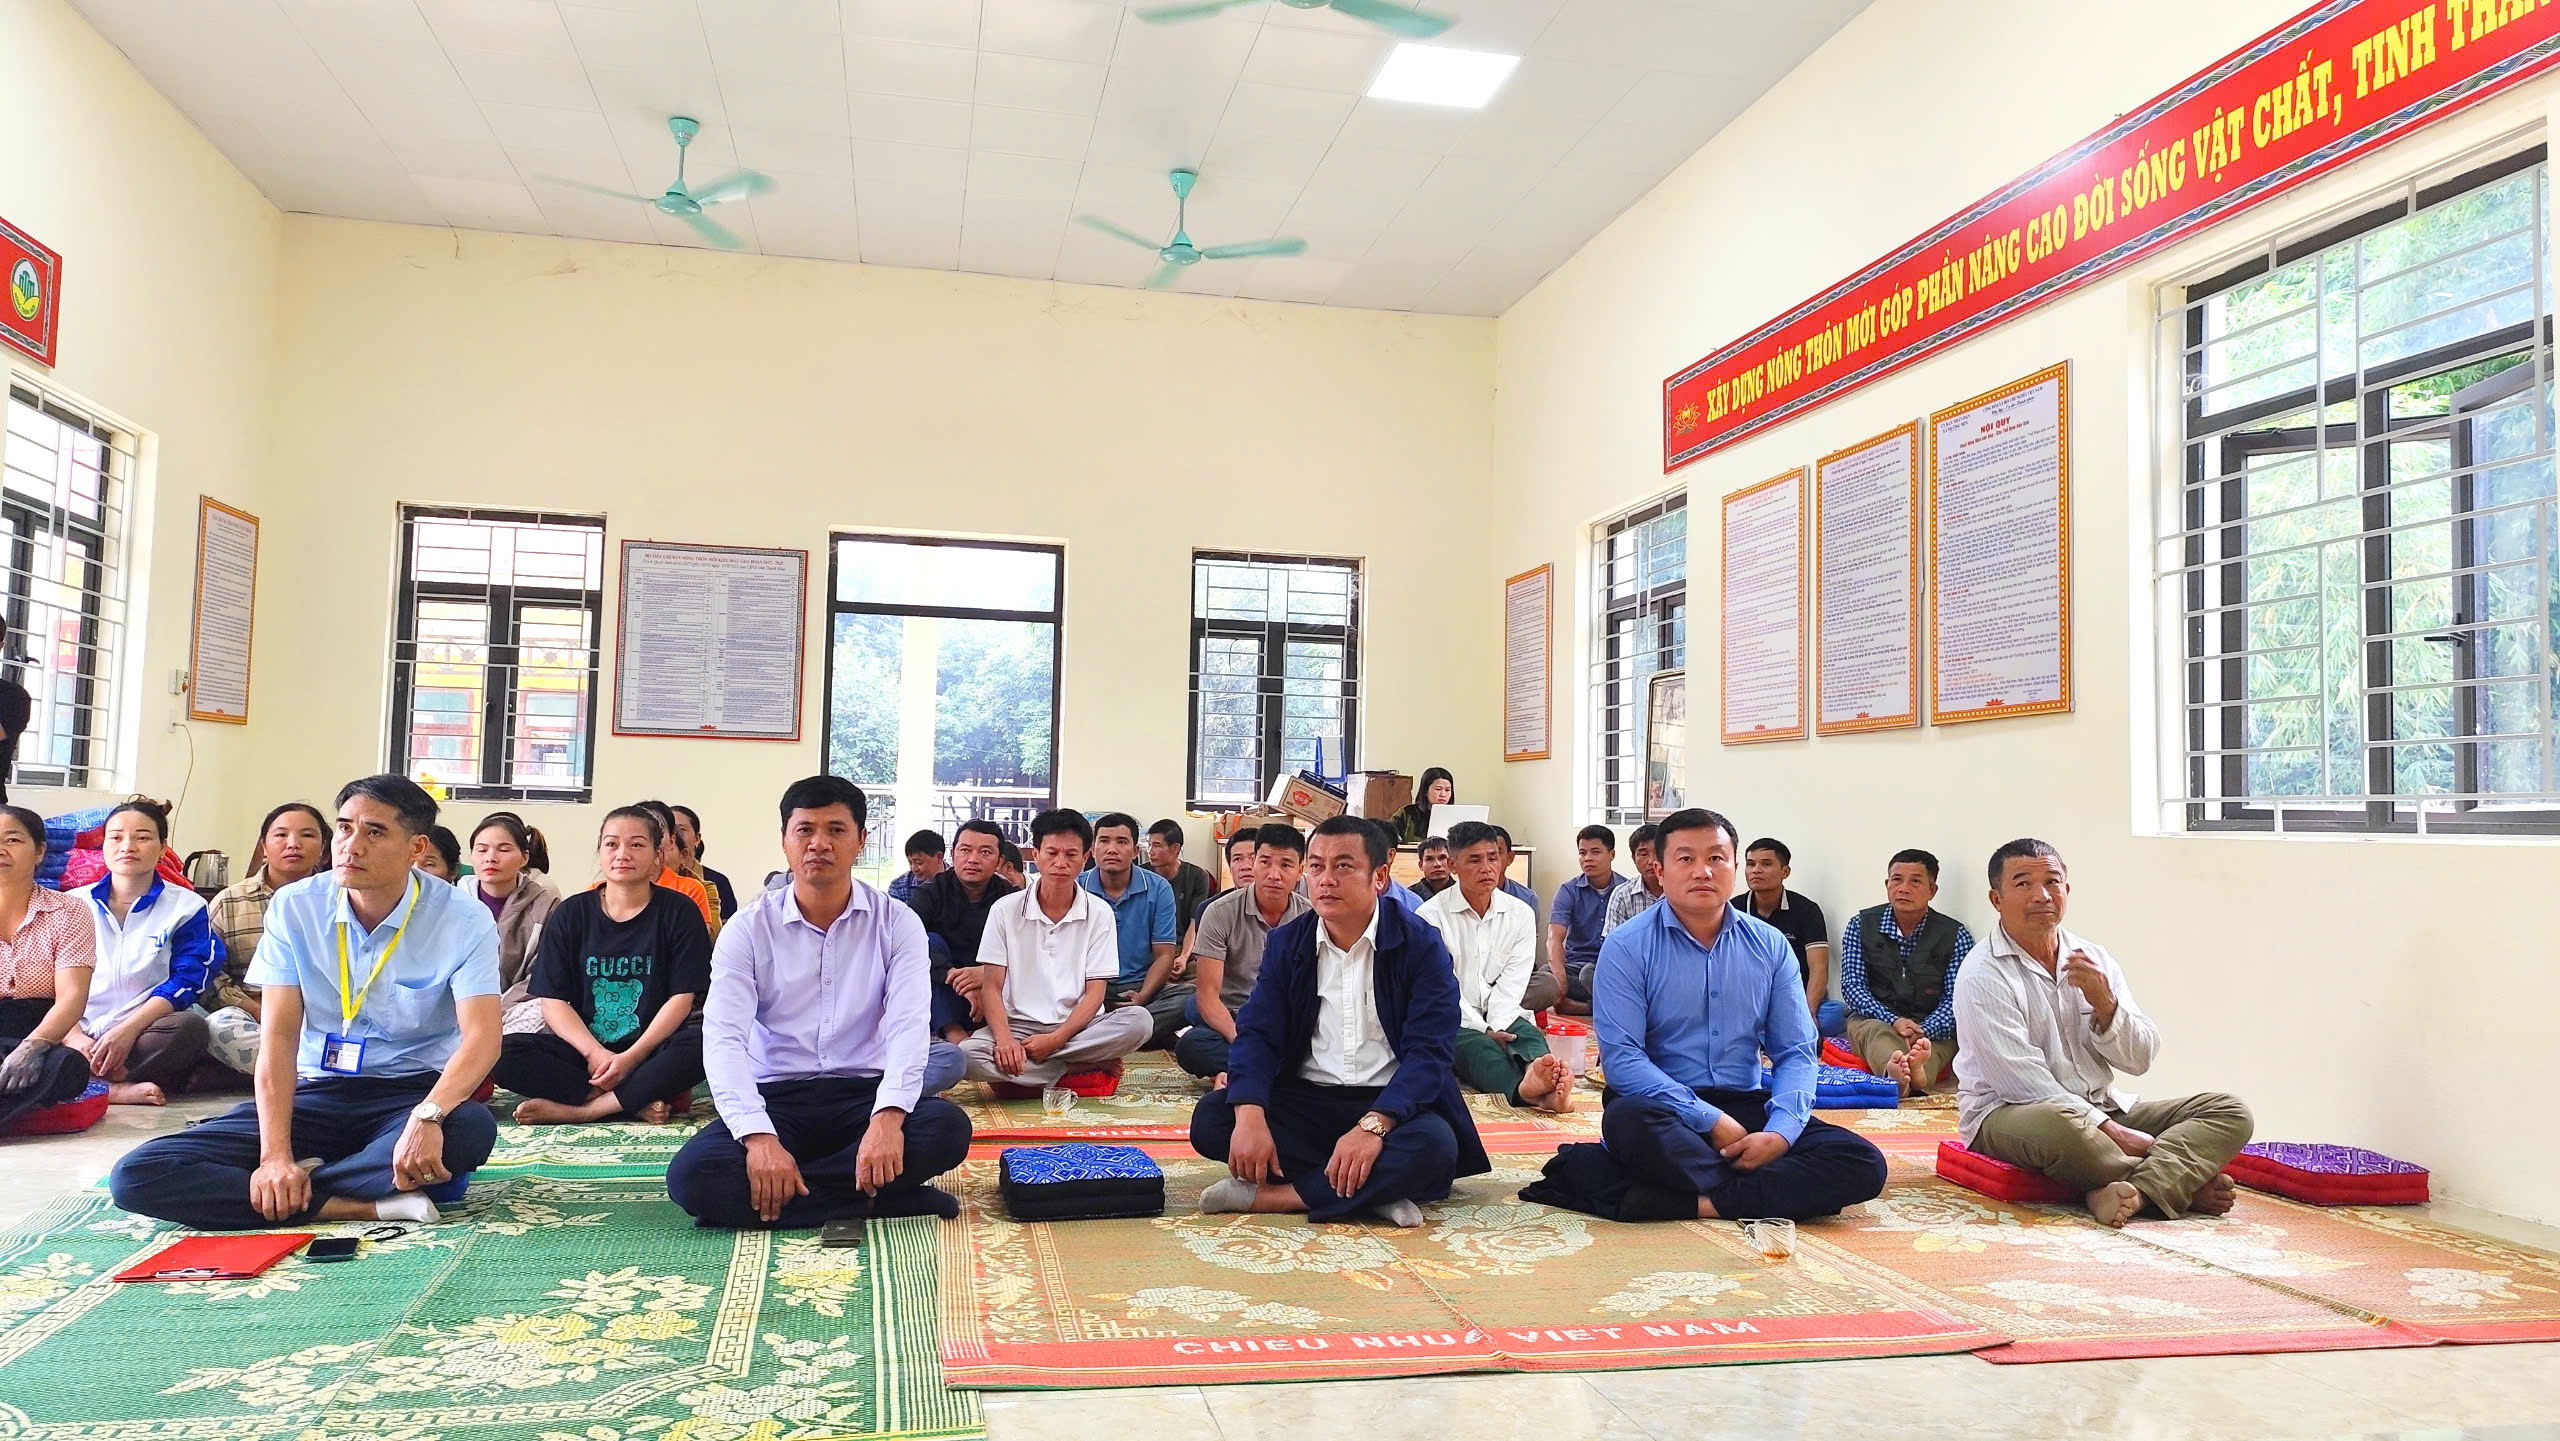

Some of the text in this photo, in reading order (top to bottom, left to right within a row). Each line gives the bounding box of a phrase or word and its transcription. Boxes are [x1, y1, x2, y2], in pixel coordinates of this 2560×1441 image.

[1706, 377, 1730, 423] XÂY
[1732, 364, 1764, 414] DỰNG
[1766, 343, 1802, 394] NÔNG
[1805, 320, 1843, 375] THÔN
[1846, 299, 1877, 355] MỚI
[1879, 282, 1913, 338] GÓP
[1916, 248, 1964, 321] PHẦN
[1968, 227, 2021, 295] NÂNG
[2026, 203, 2068, 264] CAO
[2073, 172, 2115, 242] ĐỜI
[2120, 137, 2187, 218] SỐNG
[2192, 105, 2245, 184] VẬT
[2252, 48, 2342, 149] CHẤT,
[2352, 3, 2436, 100] TINH
[1980, 422, 1994, 434] NỘI
[1995, 415, 2011, 427] QUY
[586, 956, 652, 977] GUCCI
[1173, 1337, 1329, 1354] CHIEU
[1506, 1327, 1624, 1343] VIET
[1640, 1320, 1761, 1338] NAM
